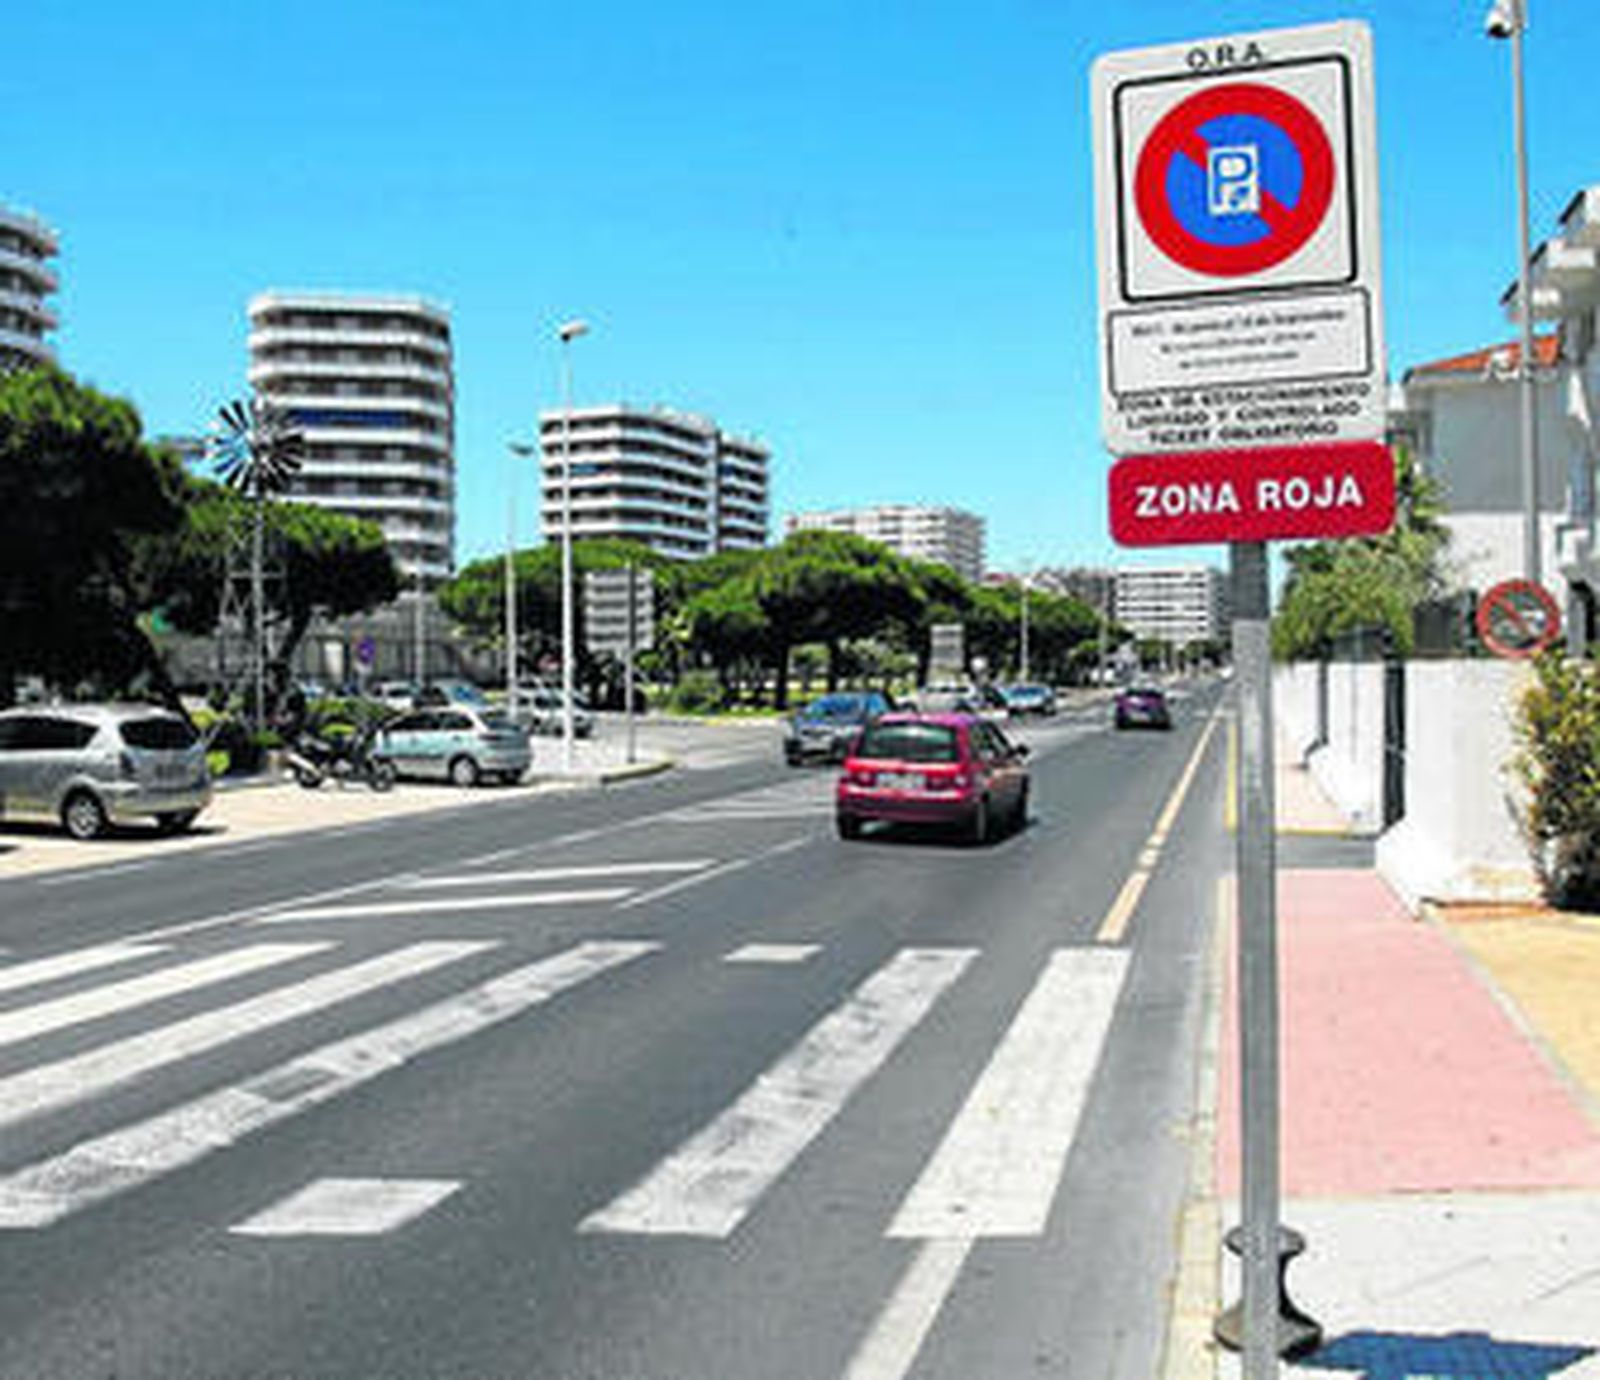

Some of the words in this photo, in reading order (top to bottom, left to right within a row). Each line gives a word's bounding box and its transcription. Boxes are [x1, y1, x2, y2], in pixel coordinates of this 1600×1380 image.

[1127, 410, 1210, 430] LIMITADO
[1216, 408, 1229, 422] Y
[1236, 400, 1362, 420] CONTROLADO
[1149, 427, 1211, 444] TICKET
[1218, 420, 1339, 441] OBLIGATORIO
[1135, 481, 1241, 518] ZONA
[1256, 475, 1365, 512] ROJA
